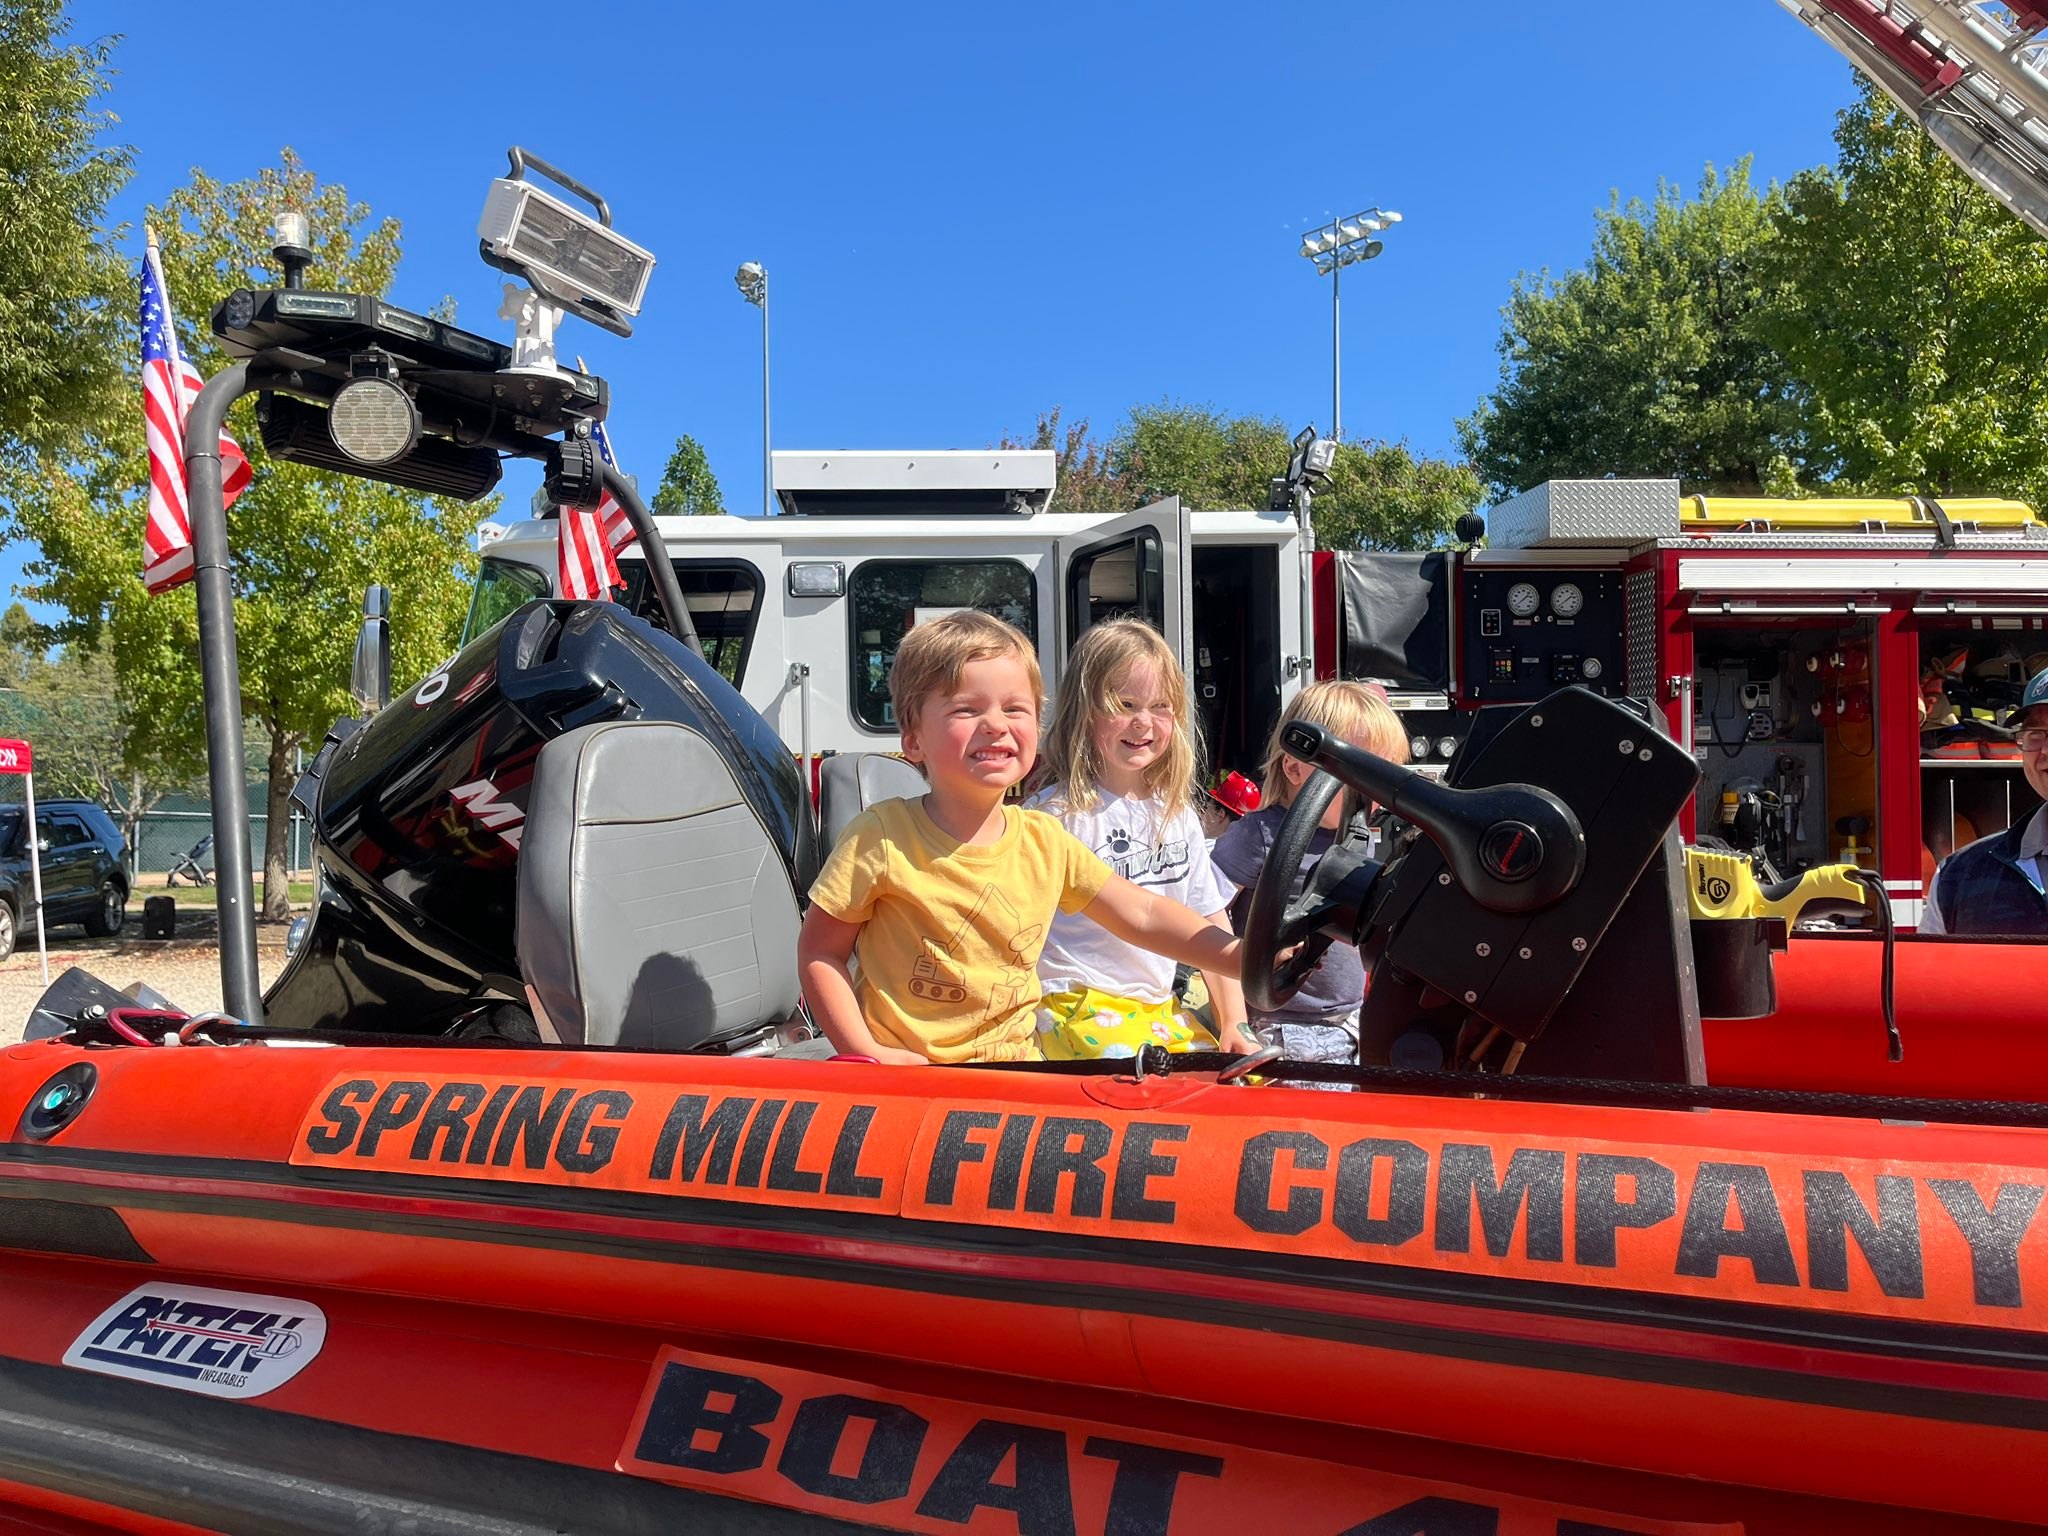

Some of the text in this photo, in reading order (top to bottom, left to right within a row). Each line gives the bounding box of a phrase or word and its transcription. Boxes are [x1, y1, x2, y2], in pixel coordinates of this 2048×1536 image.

[306, 1079, 2046, 1308] SPRING MILL FIRE COMPANY
[200, 1368, 249, 1389] INFLATABLES
[634, 1361, 1224, 1536] BOAT
